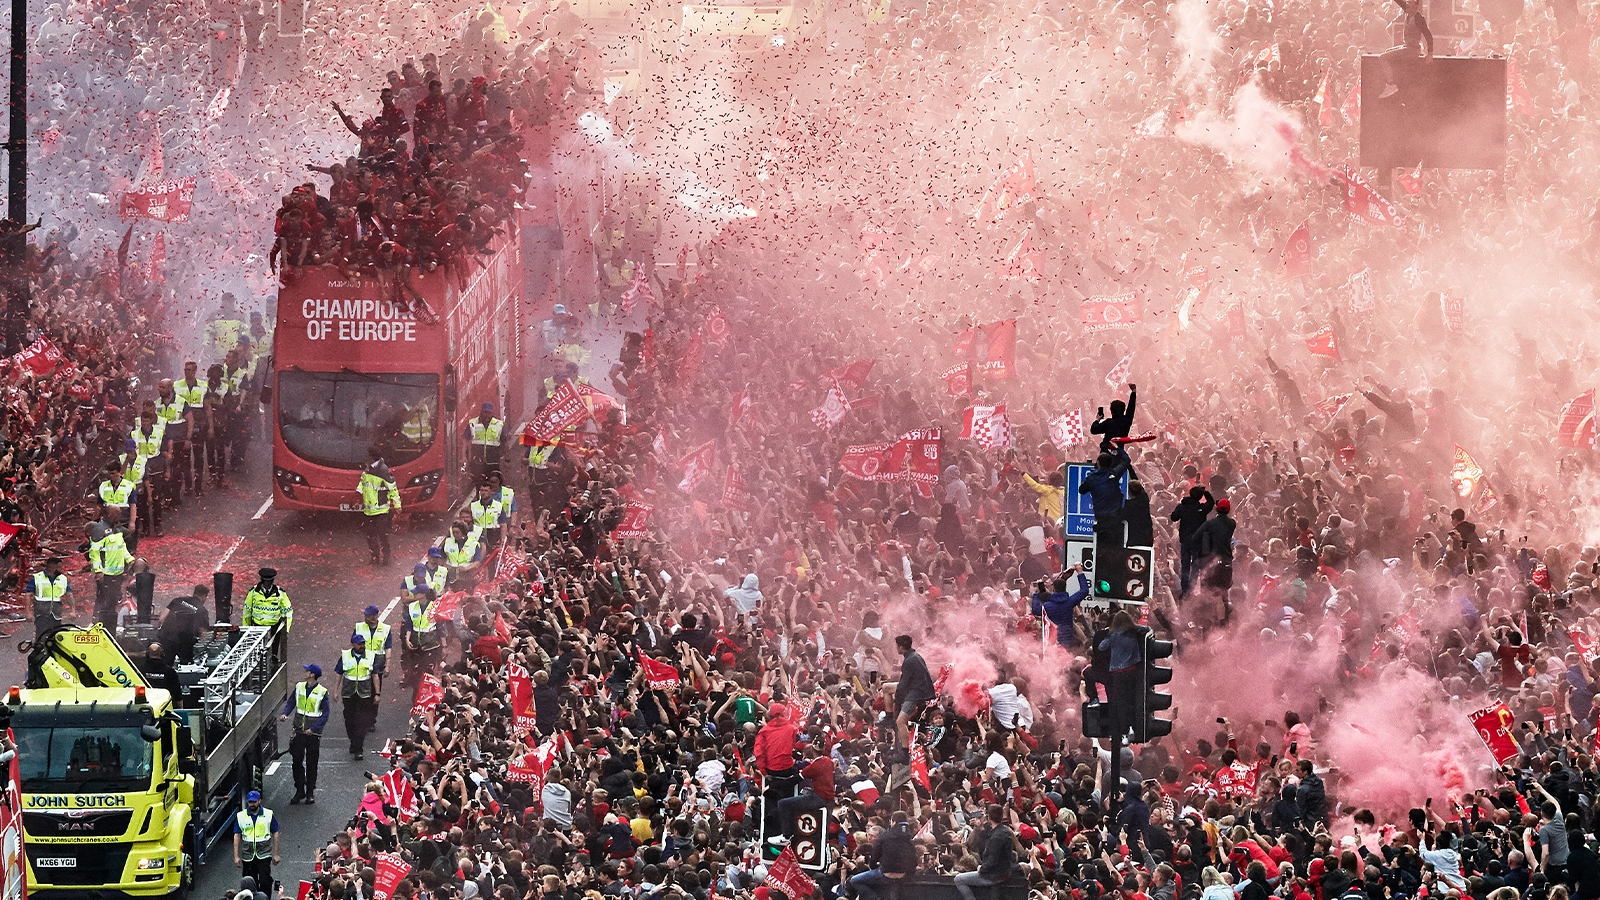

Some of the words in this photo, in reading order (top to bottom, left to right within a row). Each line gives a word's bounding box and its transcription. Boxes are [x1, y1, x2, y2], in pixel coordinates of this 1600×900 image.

[303, 299, 417, 320] CHAMPIONS
[307, 320, 332, 340] OF
[339, 321, 416, 342] EUROPE
[27, 796, 68, 807] JOHN
[75, 795, 125, 807] SUTCH
[58, 822, 95, 831] MAN
